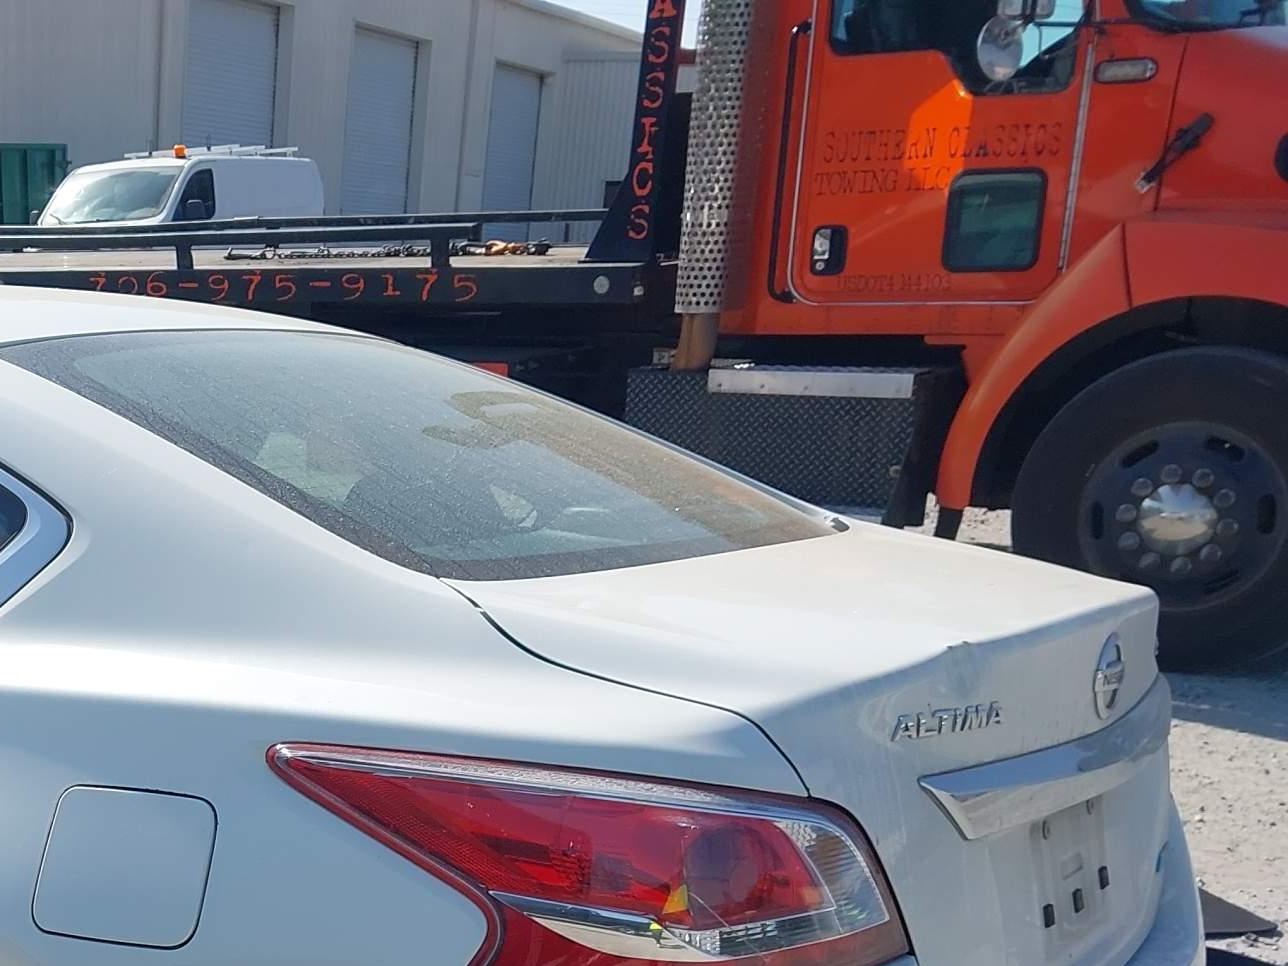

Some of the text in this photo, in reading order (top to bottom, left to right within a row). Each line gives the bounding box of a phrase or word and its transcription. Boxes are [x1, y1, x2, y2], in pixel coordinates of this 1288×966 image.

[823, 123, 1062, 163] SOUTHERN CLASSICS
[815, 166, 951, 196] TOWING LLC
[890, 700, 1002, 742] ALTIMA
